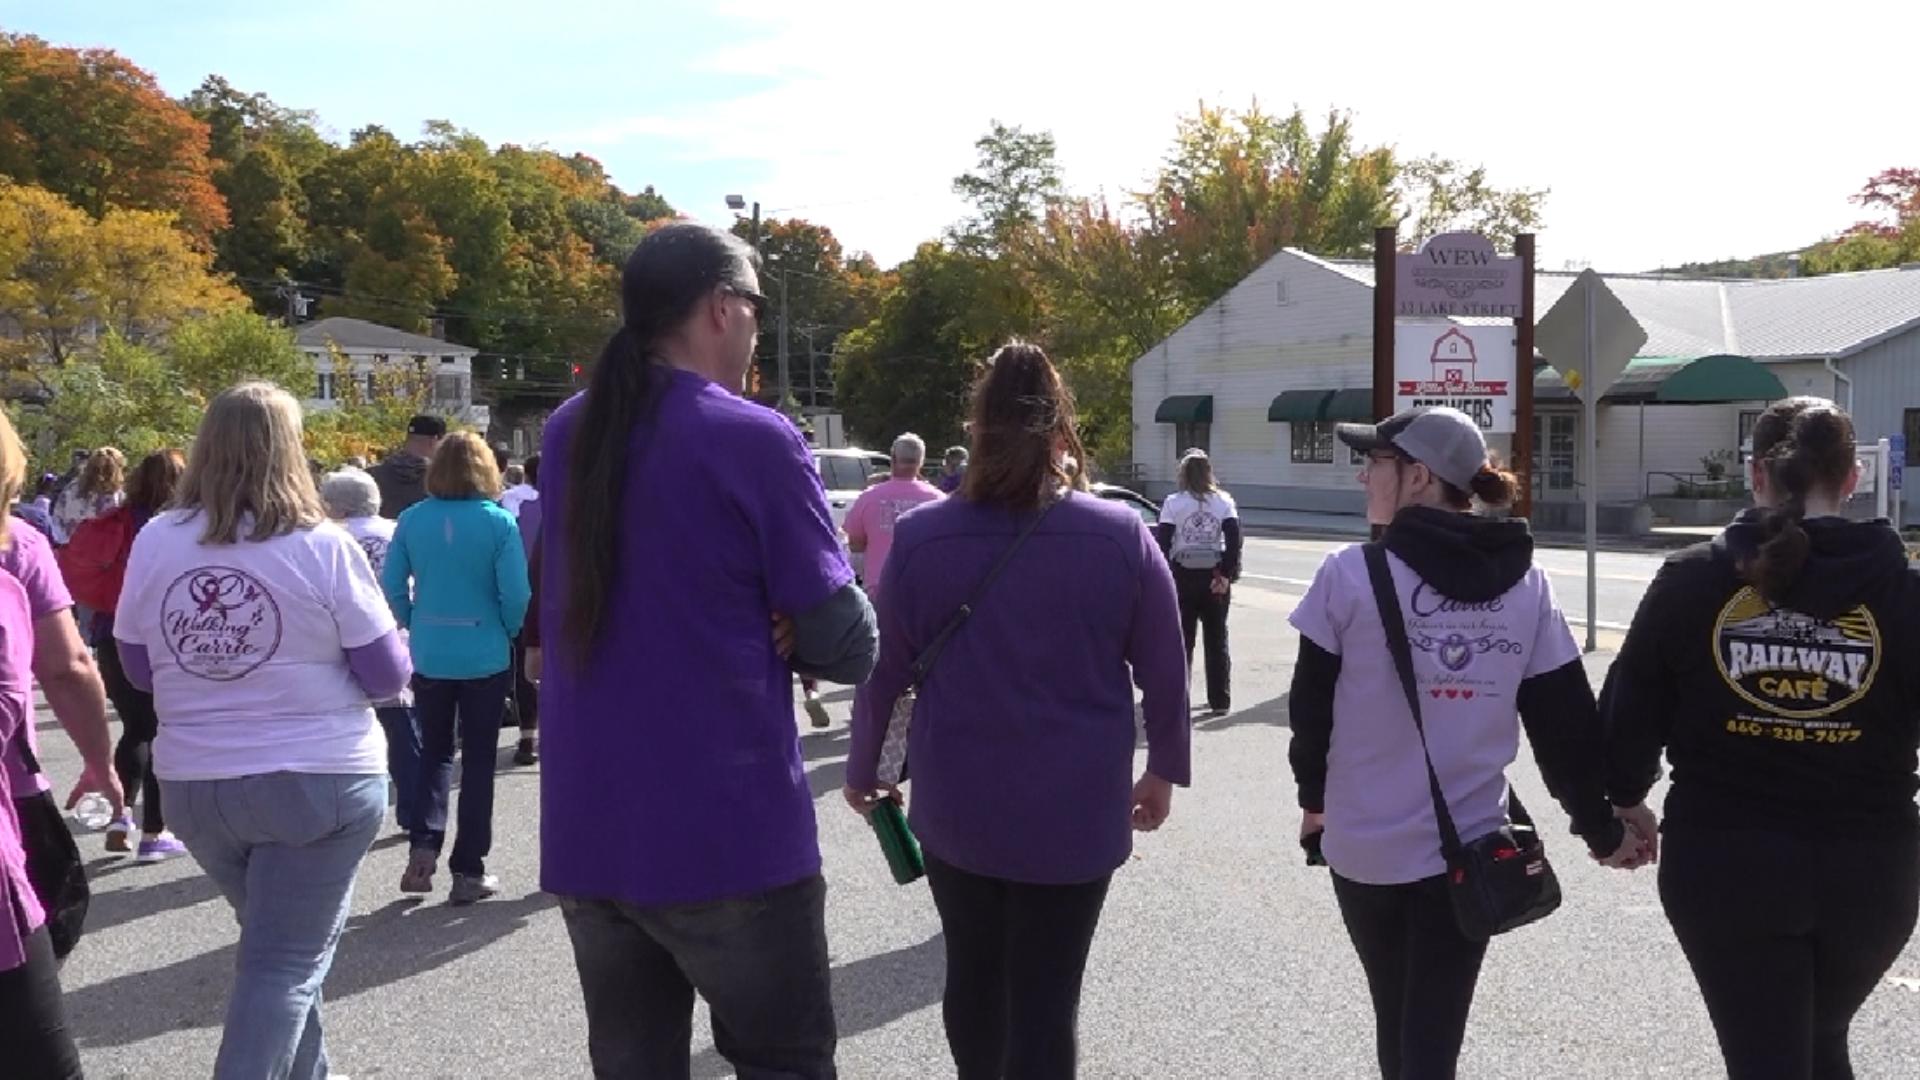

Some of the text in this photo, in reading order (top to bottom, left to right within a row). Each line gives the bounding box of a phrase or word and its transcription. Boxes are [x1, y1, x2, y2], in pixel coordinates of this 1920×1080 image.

[1428, 249, 1492, 267] WEW
[1419, 301, 1457, 315] LAKE
[1463, 302, 1518, 315] STREET
[166, 609, 251, 639] Walking
[177, 633, 261, 655] Carrie
[1729, 641, 1867, 692] RAILWAY
[1758, 677, 1829, 701] CAFÉ
